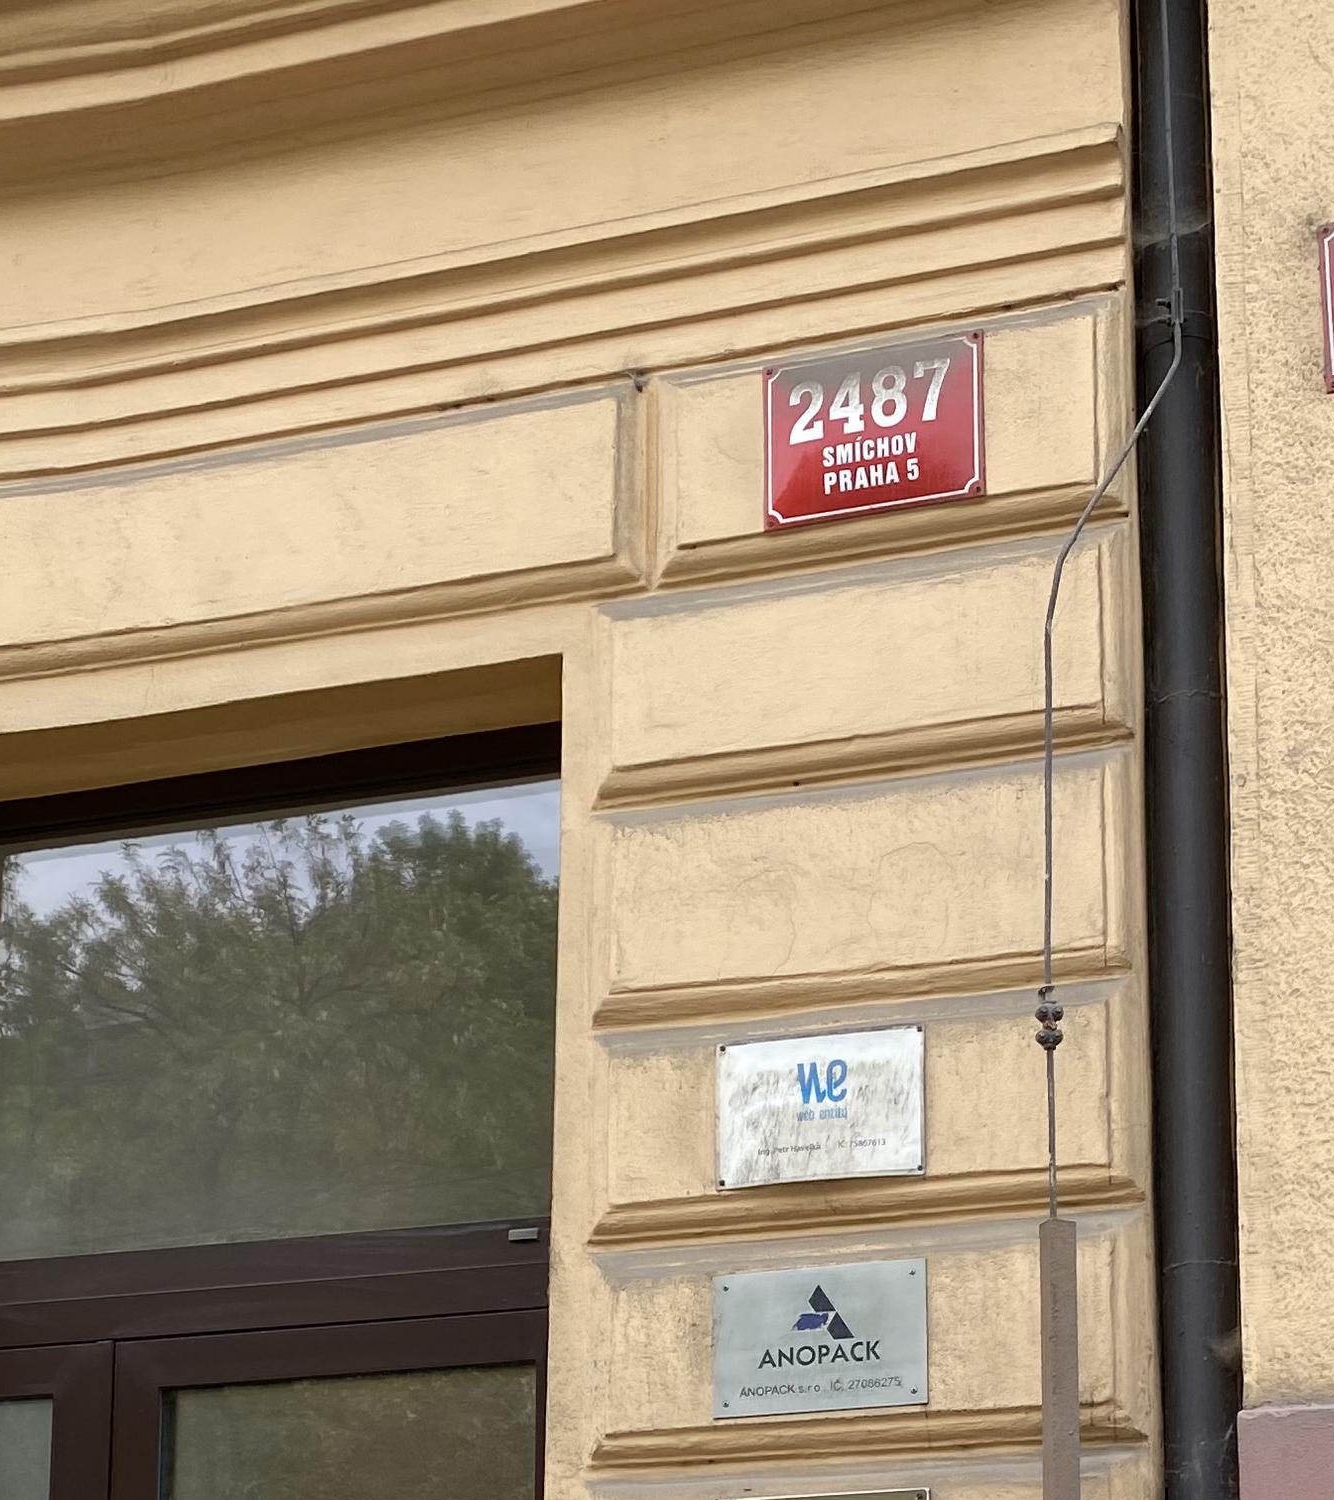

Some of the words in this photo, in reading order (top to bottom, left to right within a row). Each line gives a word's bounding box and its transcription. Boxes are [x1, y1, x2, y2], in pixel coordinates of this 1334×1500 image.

[788, 357, 951, 445] 2487
[822, 432, 917, 467] SMÍCHOV
[823, 461, 900, 495] PRAHA
[906, 458, 920, 480] 5
[758, 1339, 881, 1369] ANOPACK
[739, 1384, 795, 1398] ANOPACK
